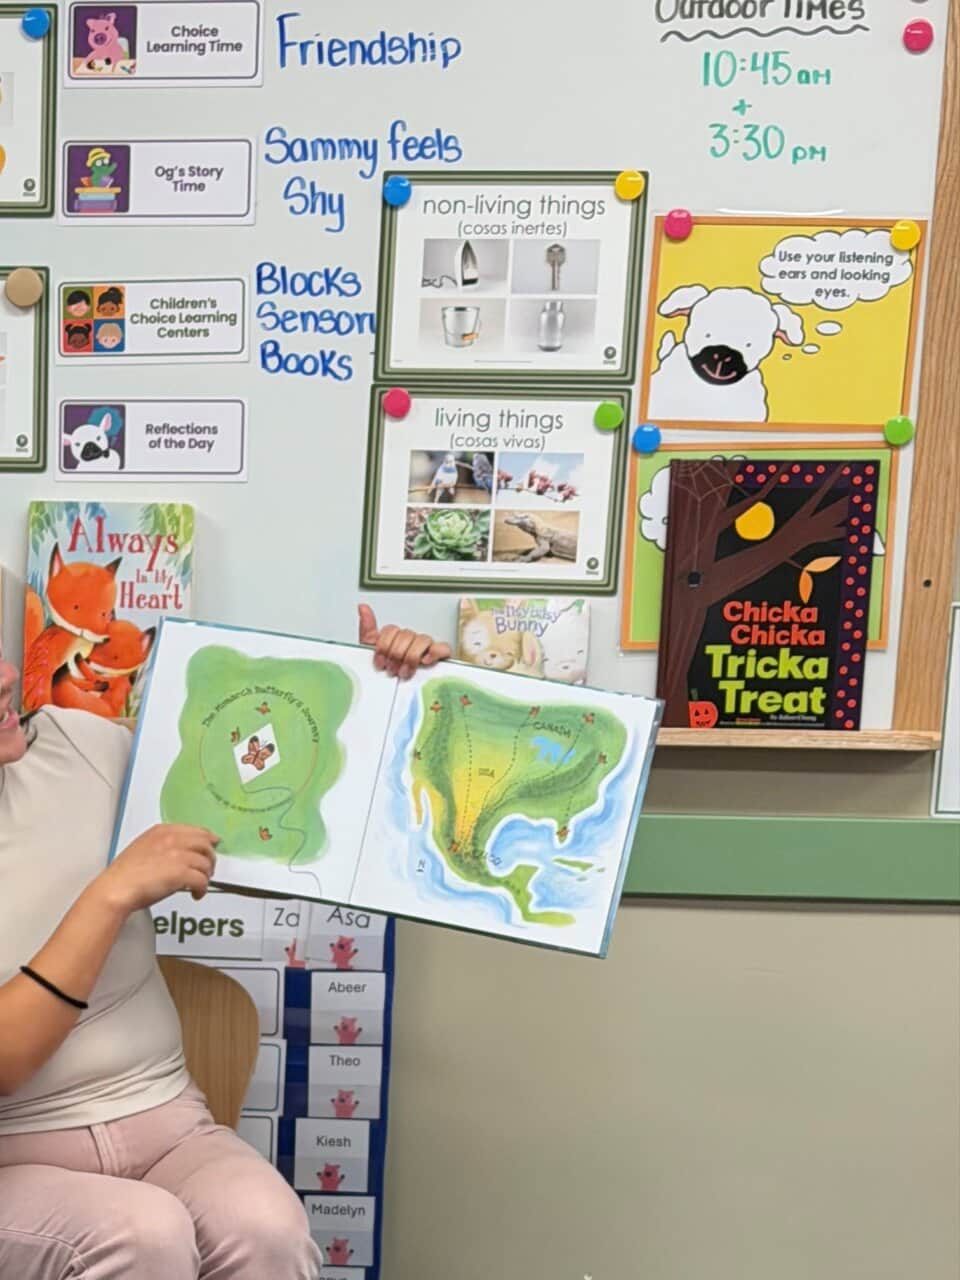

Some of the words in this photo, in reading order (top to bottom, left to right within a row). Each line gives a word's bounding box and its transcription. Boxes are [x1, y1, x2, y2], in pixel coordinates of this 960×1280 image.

[171, 25, 219, 38] Choice
[146, 40, 206, 56] Learning
[212, 40, 242, 53] Time
[277, 12, 462, 70] Friendship
[703, 50, 792, 87] 10:45
[264, 127, 378, 179] Sammy
[387, 120, 462, 162] feels
[709, 123, 785, 161] 3:30
[155, 166, 183, 181] Og's
[188, 166, 223, 181] Story
[173, 181, 206, 193] Time
[283, 176, 346, 233] Shy
[422, 196, 532, 219] non-living
[539, 198, 606, 220] things
[457, 221, 507, 236] (cosas
[511, 221, 568, 237] inertes)
[778, 250, 802, 262] Use
[806, 254, 836, 265] your
[839, 250, 894, 265] listening
[778, 269, 807, 280] ears
[810, 267, 838, 280] and
[840, 269, 890, 284] looking
[814, 286, 850, 299] eyes.
[150, 297, 217, 310] Children's
[130, 313, 176, 325] Choice
[179, 311, 237, 327] Learning
[157, 326, 210, 339] Centers
[434, 408, 491, 432] living
[498, 410, 564, 433] things
[145, 422, 218, 436] Reflections
[148, 437, 161, 449] of
[165, 437, 185, 449] the
[189, 437, 214, 453] Day
[449, 434, 499, 449] (cosas
[503, 436, 546, 450] vivas)
[67, 515, 180, 572] Always
[119, 580, 183, 610] Heart
[722, 601, 819, 624] Chicka
[495, 615, 549, 638] Bunny
[730, 624, 826, 646] Chicka
[705, 644, 829, 679] Tricka
[718, 680, 827, 715] Treat
[327, 904, 371, 929] Asa
[153, 911, 245, 943] elpers
[328, 981, 367, 994] Abeer
[330, 1055, 361, 1067] Theo
[316, 1135, 351, 1148] Kiesh
[311, 1203, 366, 1217] Madelyn
